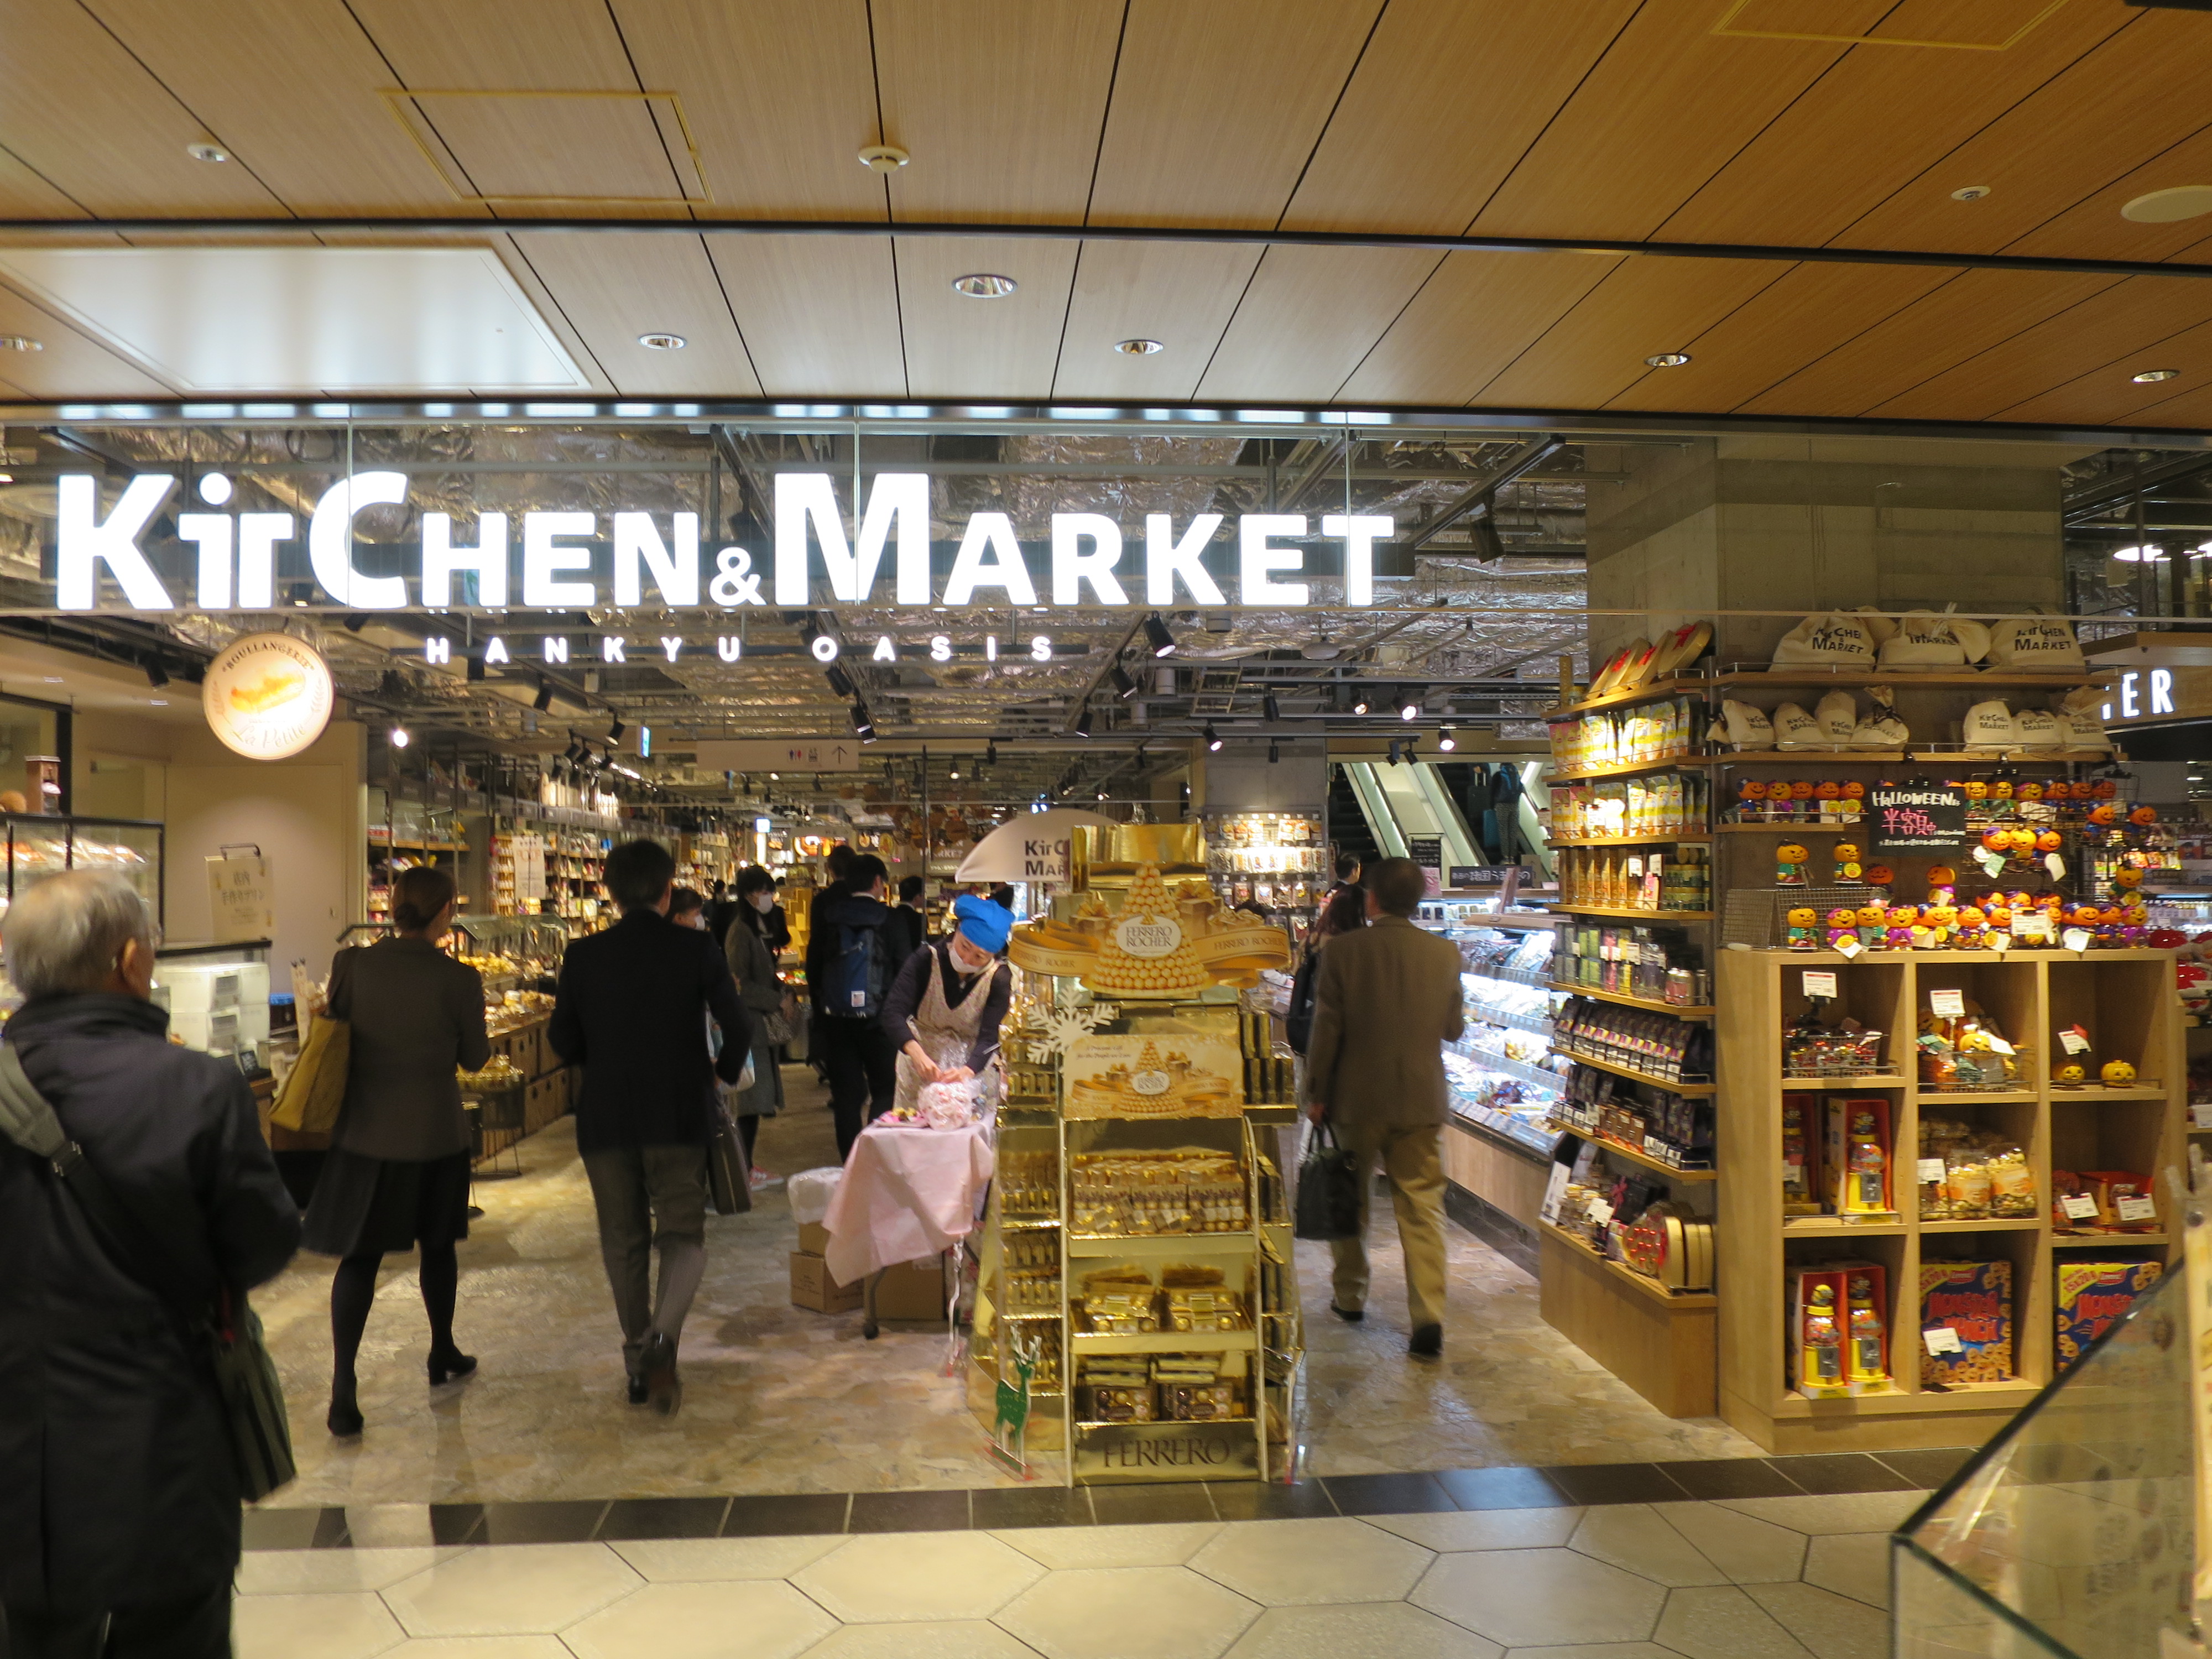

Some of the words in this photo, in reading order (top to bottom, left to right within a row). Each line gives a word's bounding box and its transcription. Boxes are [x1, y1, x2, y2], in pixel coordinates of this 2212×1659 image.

[427, 637, 739, 663] HANKYU
[812, 636, 1051, 661] OASIS
[1813, 637, 1864, 654] MARKET
[2015, 639, 2071, 651] MARKET
[1104, 1438, 1230, 1467] FERRERO
